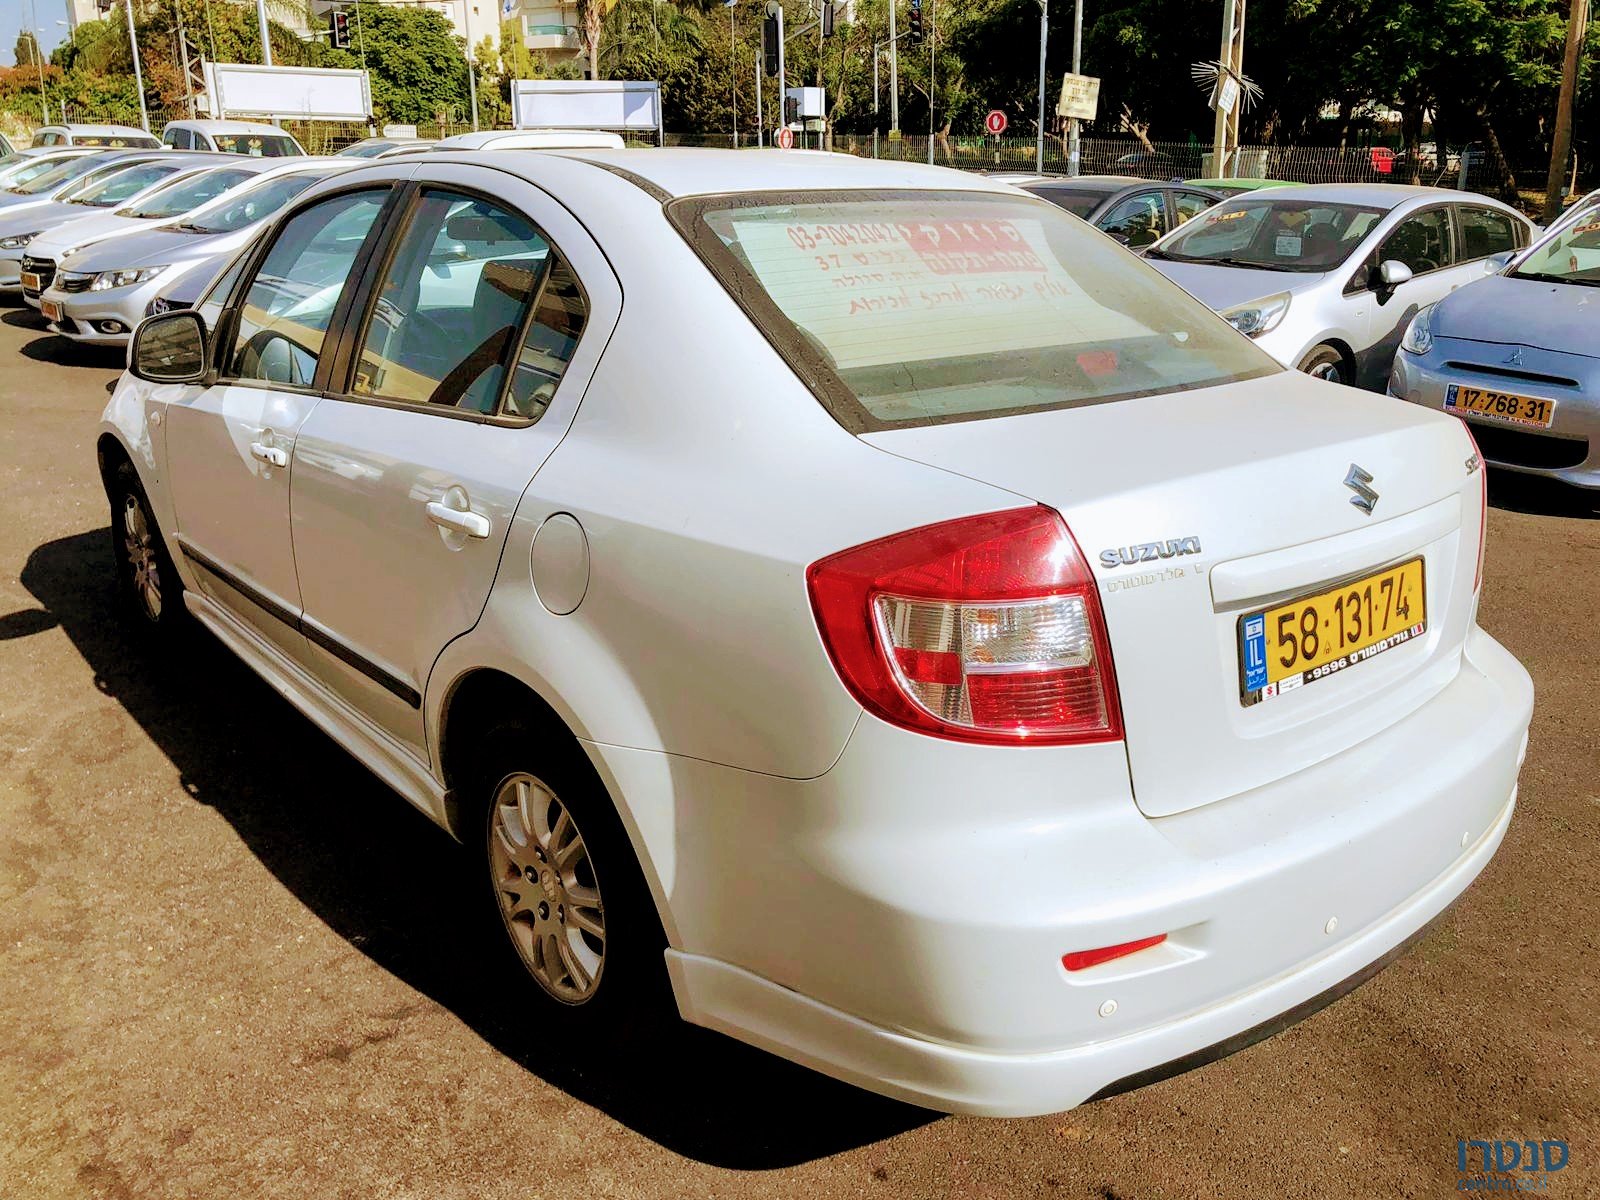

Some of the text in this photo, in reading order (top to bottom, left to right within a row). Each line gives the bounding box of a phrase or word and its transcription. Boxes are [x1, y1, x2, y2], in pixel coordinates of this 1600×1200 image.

[815, 254, 841, 271] 37
[1099, 536, 1202, 568] SUZUKI
[1249, 638, 1263, 667] IL
[1349, 630, 1409, 664] גולדמוטורס
